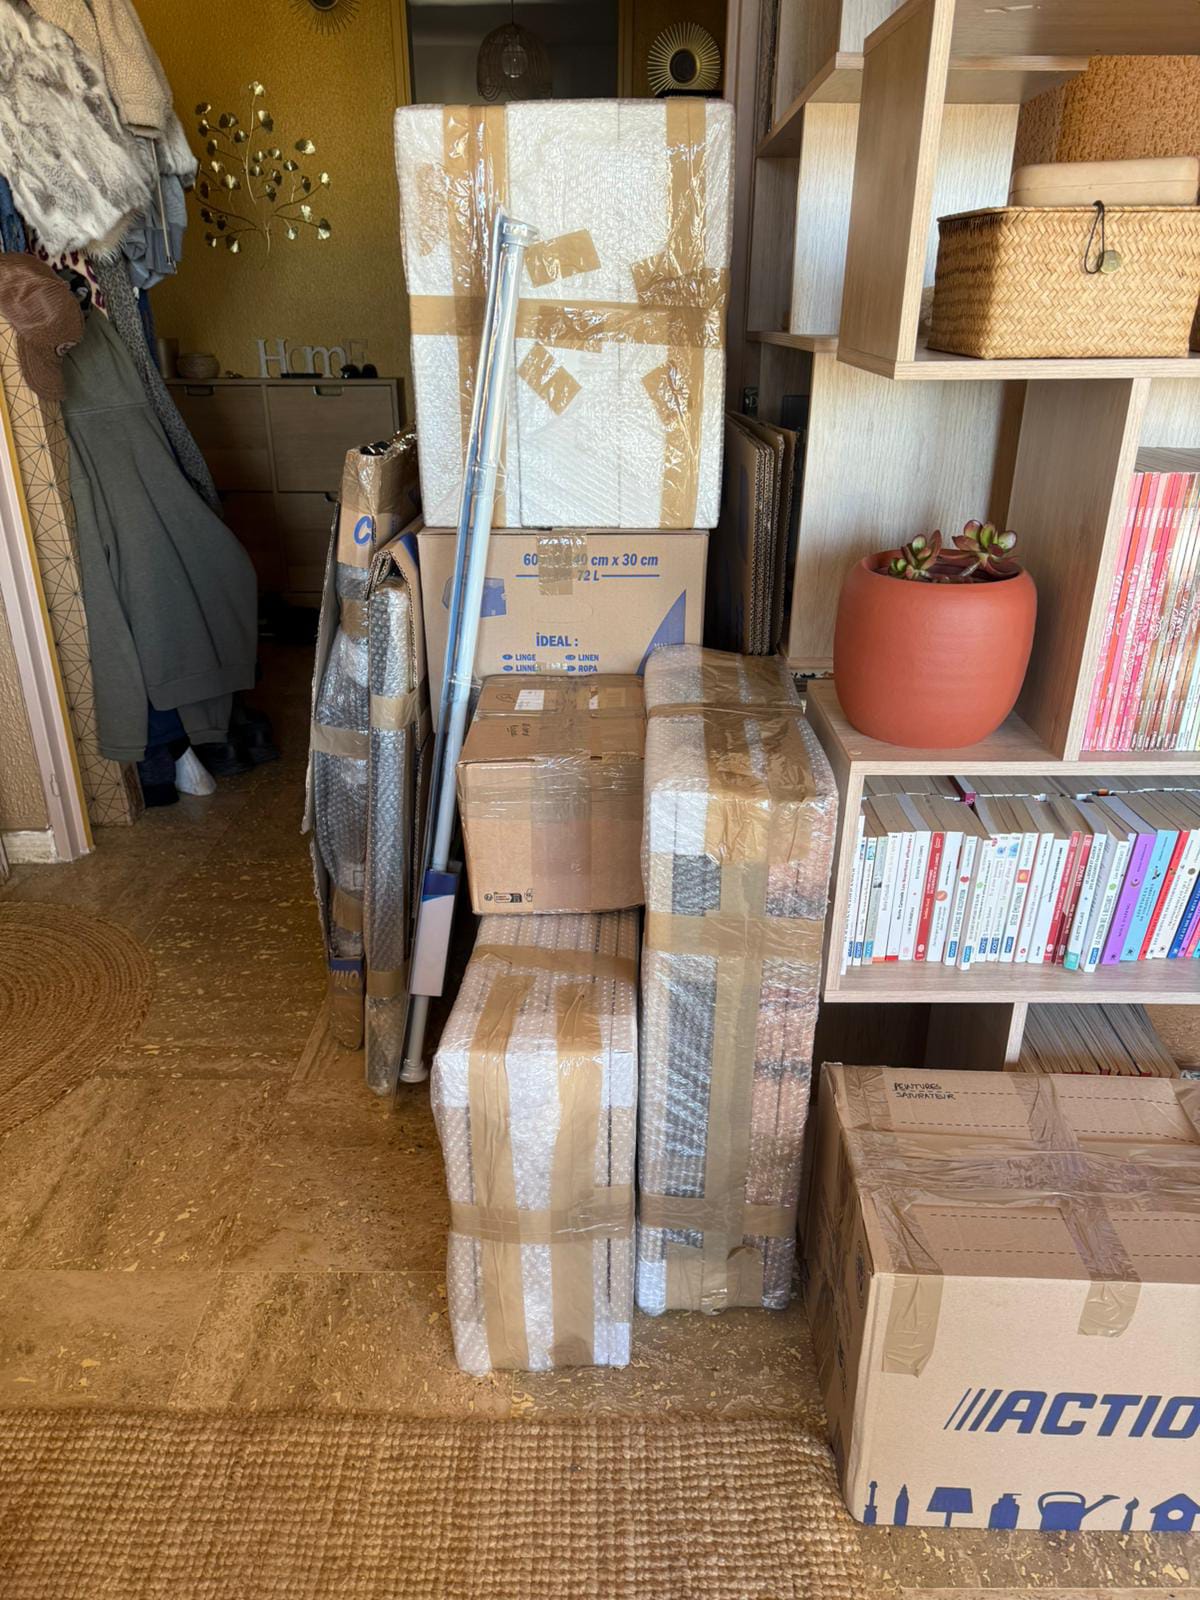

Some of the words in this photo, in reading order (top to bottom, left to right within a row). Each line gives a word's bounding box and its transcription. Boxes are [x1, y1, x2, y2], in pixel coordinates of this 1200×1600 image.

[591, 556, 609, 567] cm
[611, 557, 620, 566] x
[622, 553, 638, 567] 30
[640, 556, 659, 567] cm
[577, 570, 591, 581] 72
[593, 570, 600, 581] L
